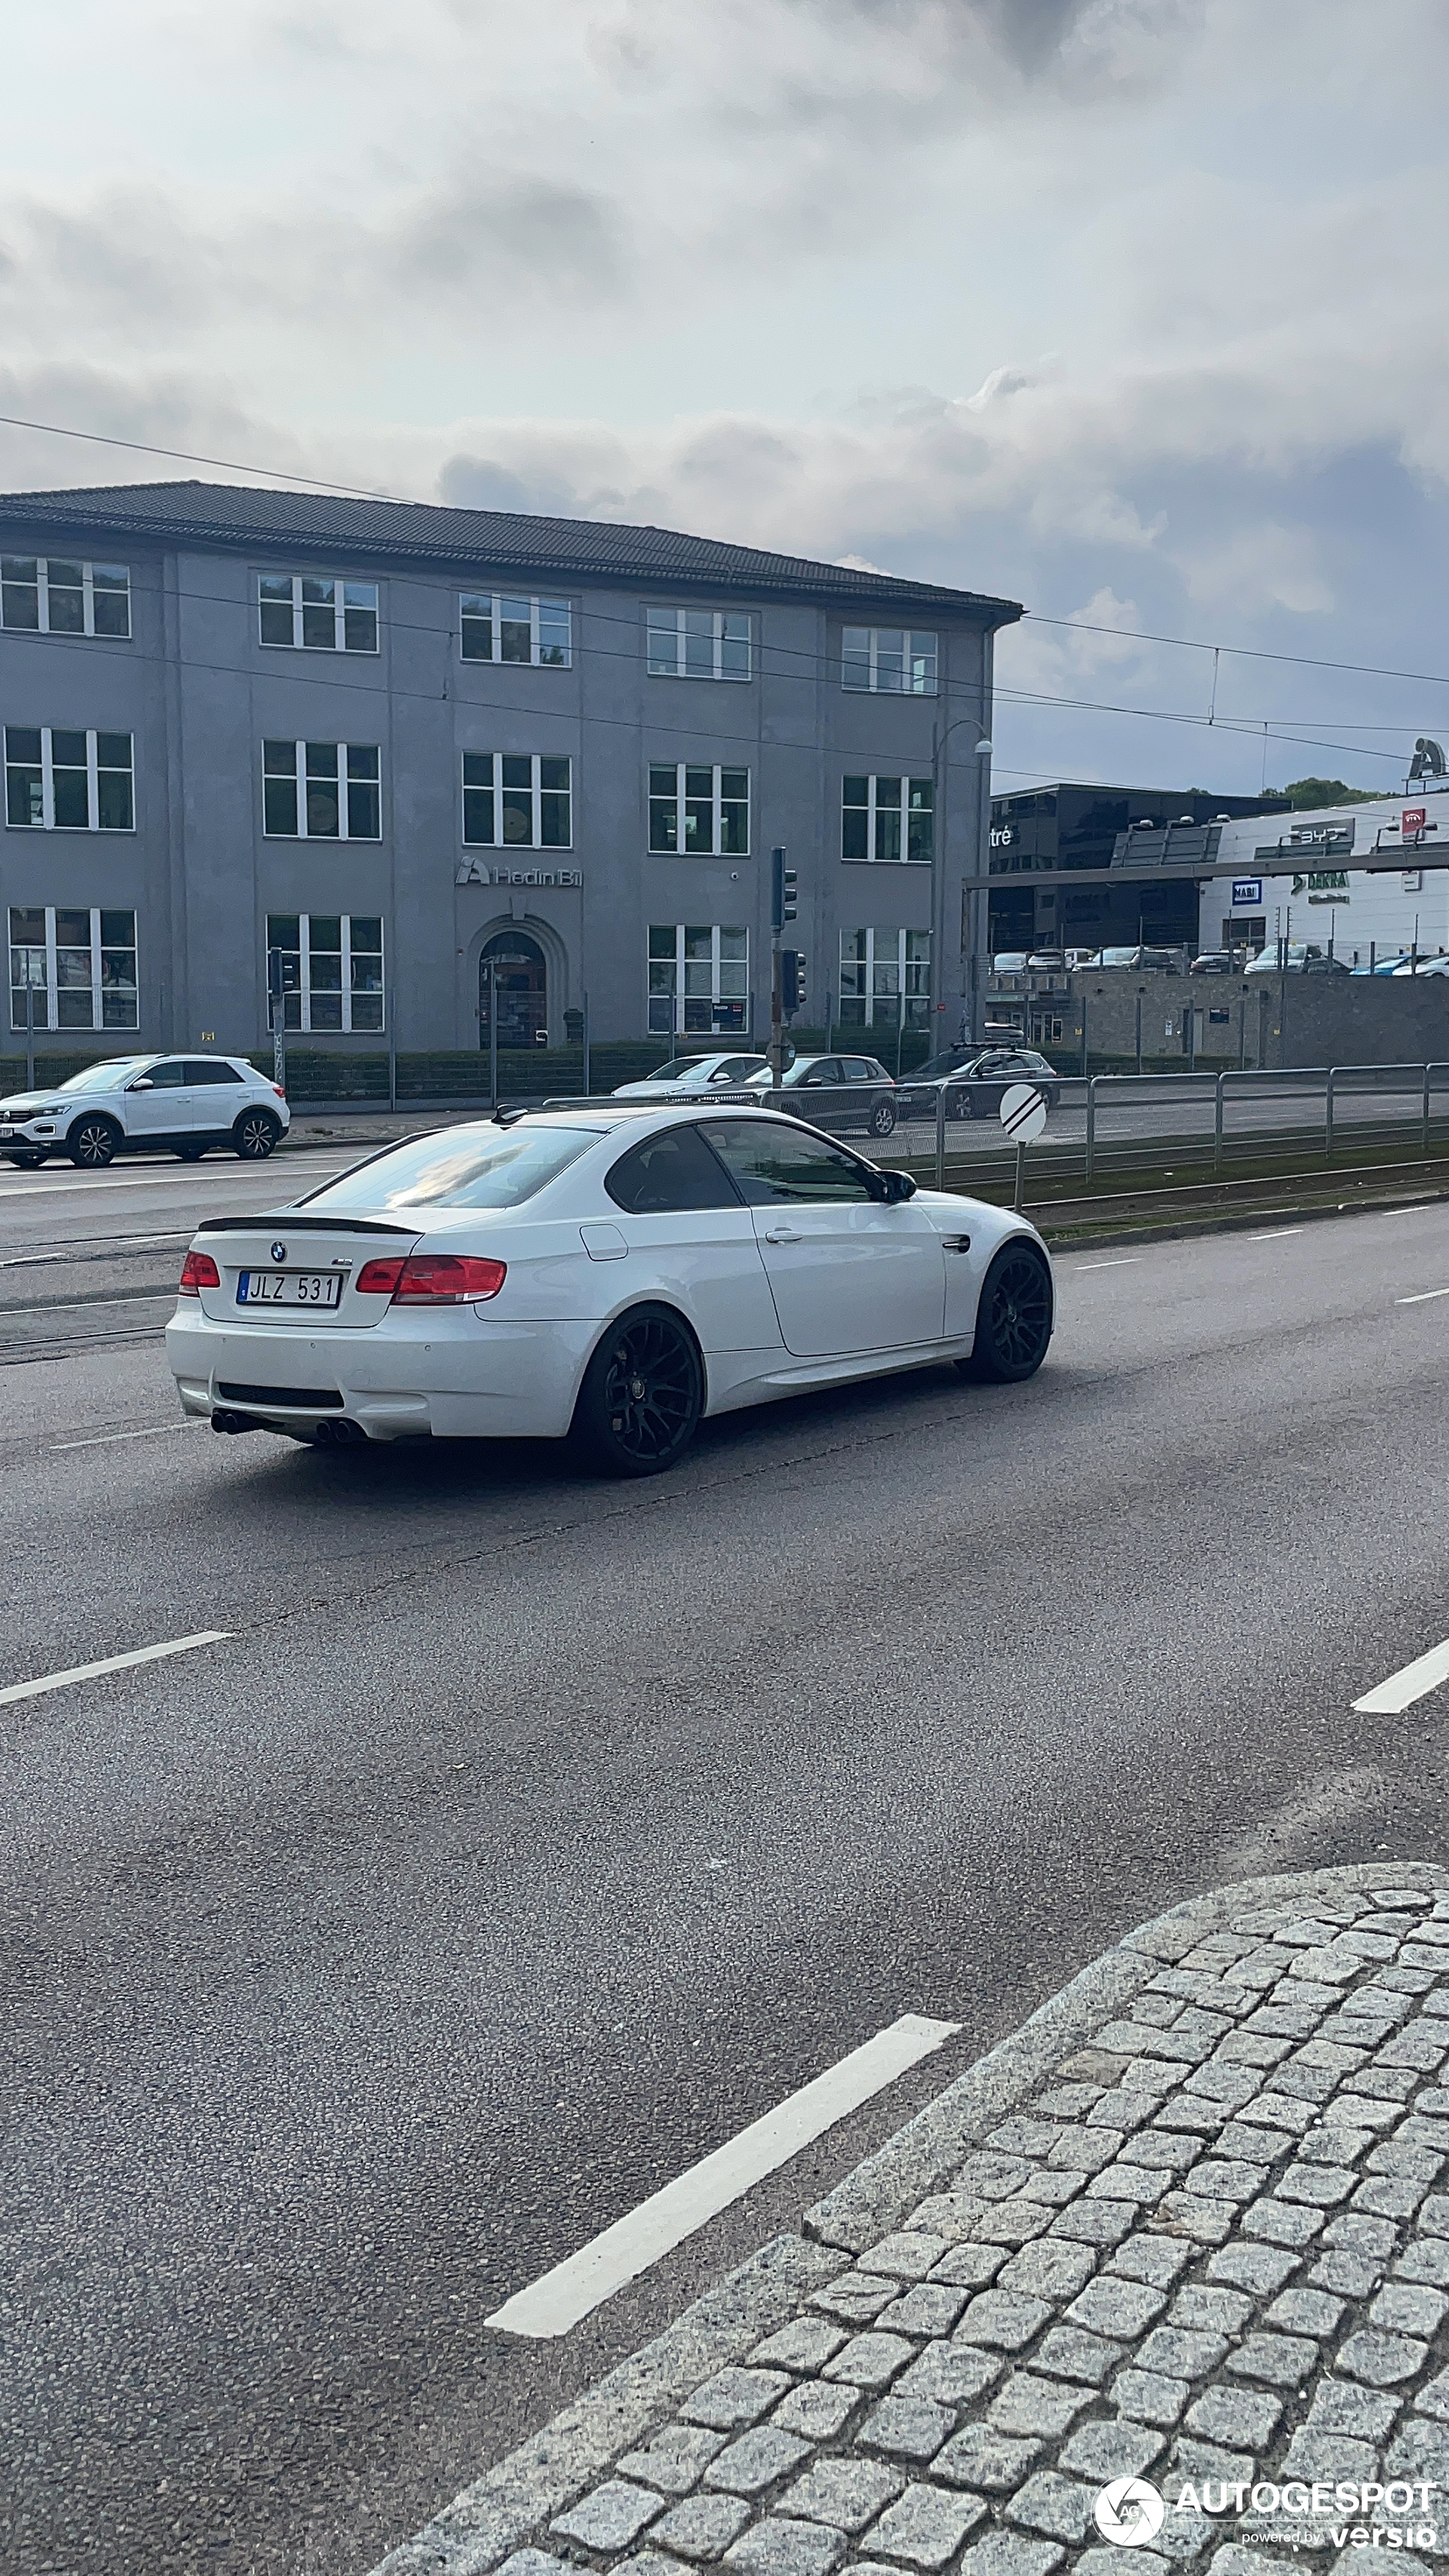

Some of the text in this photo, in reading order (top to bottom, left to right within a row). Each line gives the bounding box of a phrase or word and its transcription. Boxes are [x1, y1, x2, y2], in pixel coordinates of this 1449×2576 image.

[989, 825, 1011, 846] tré
[493, 866, 584, 886] Hedin Bil
[1308, 872, 1347, 890] DEKRA
[250, 1275, 333, 1302] JLZ 531
